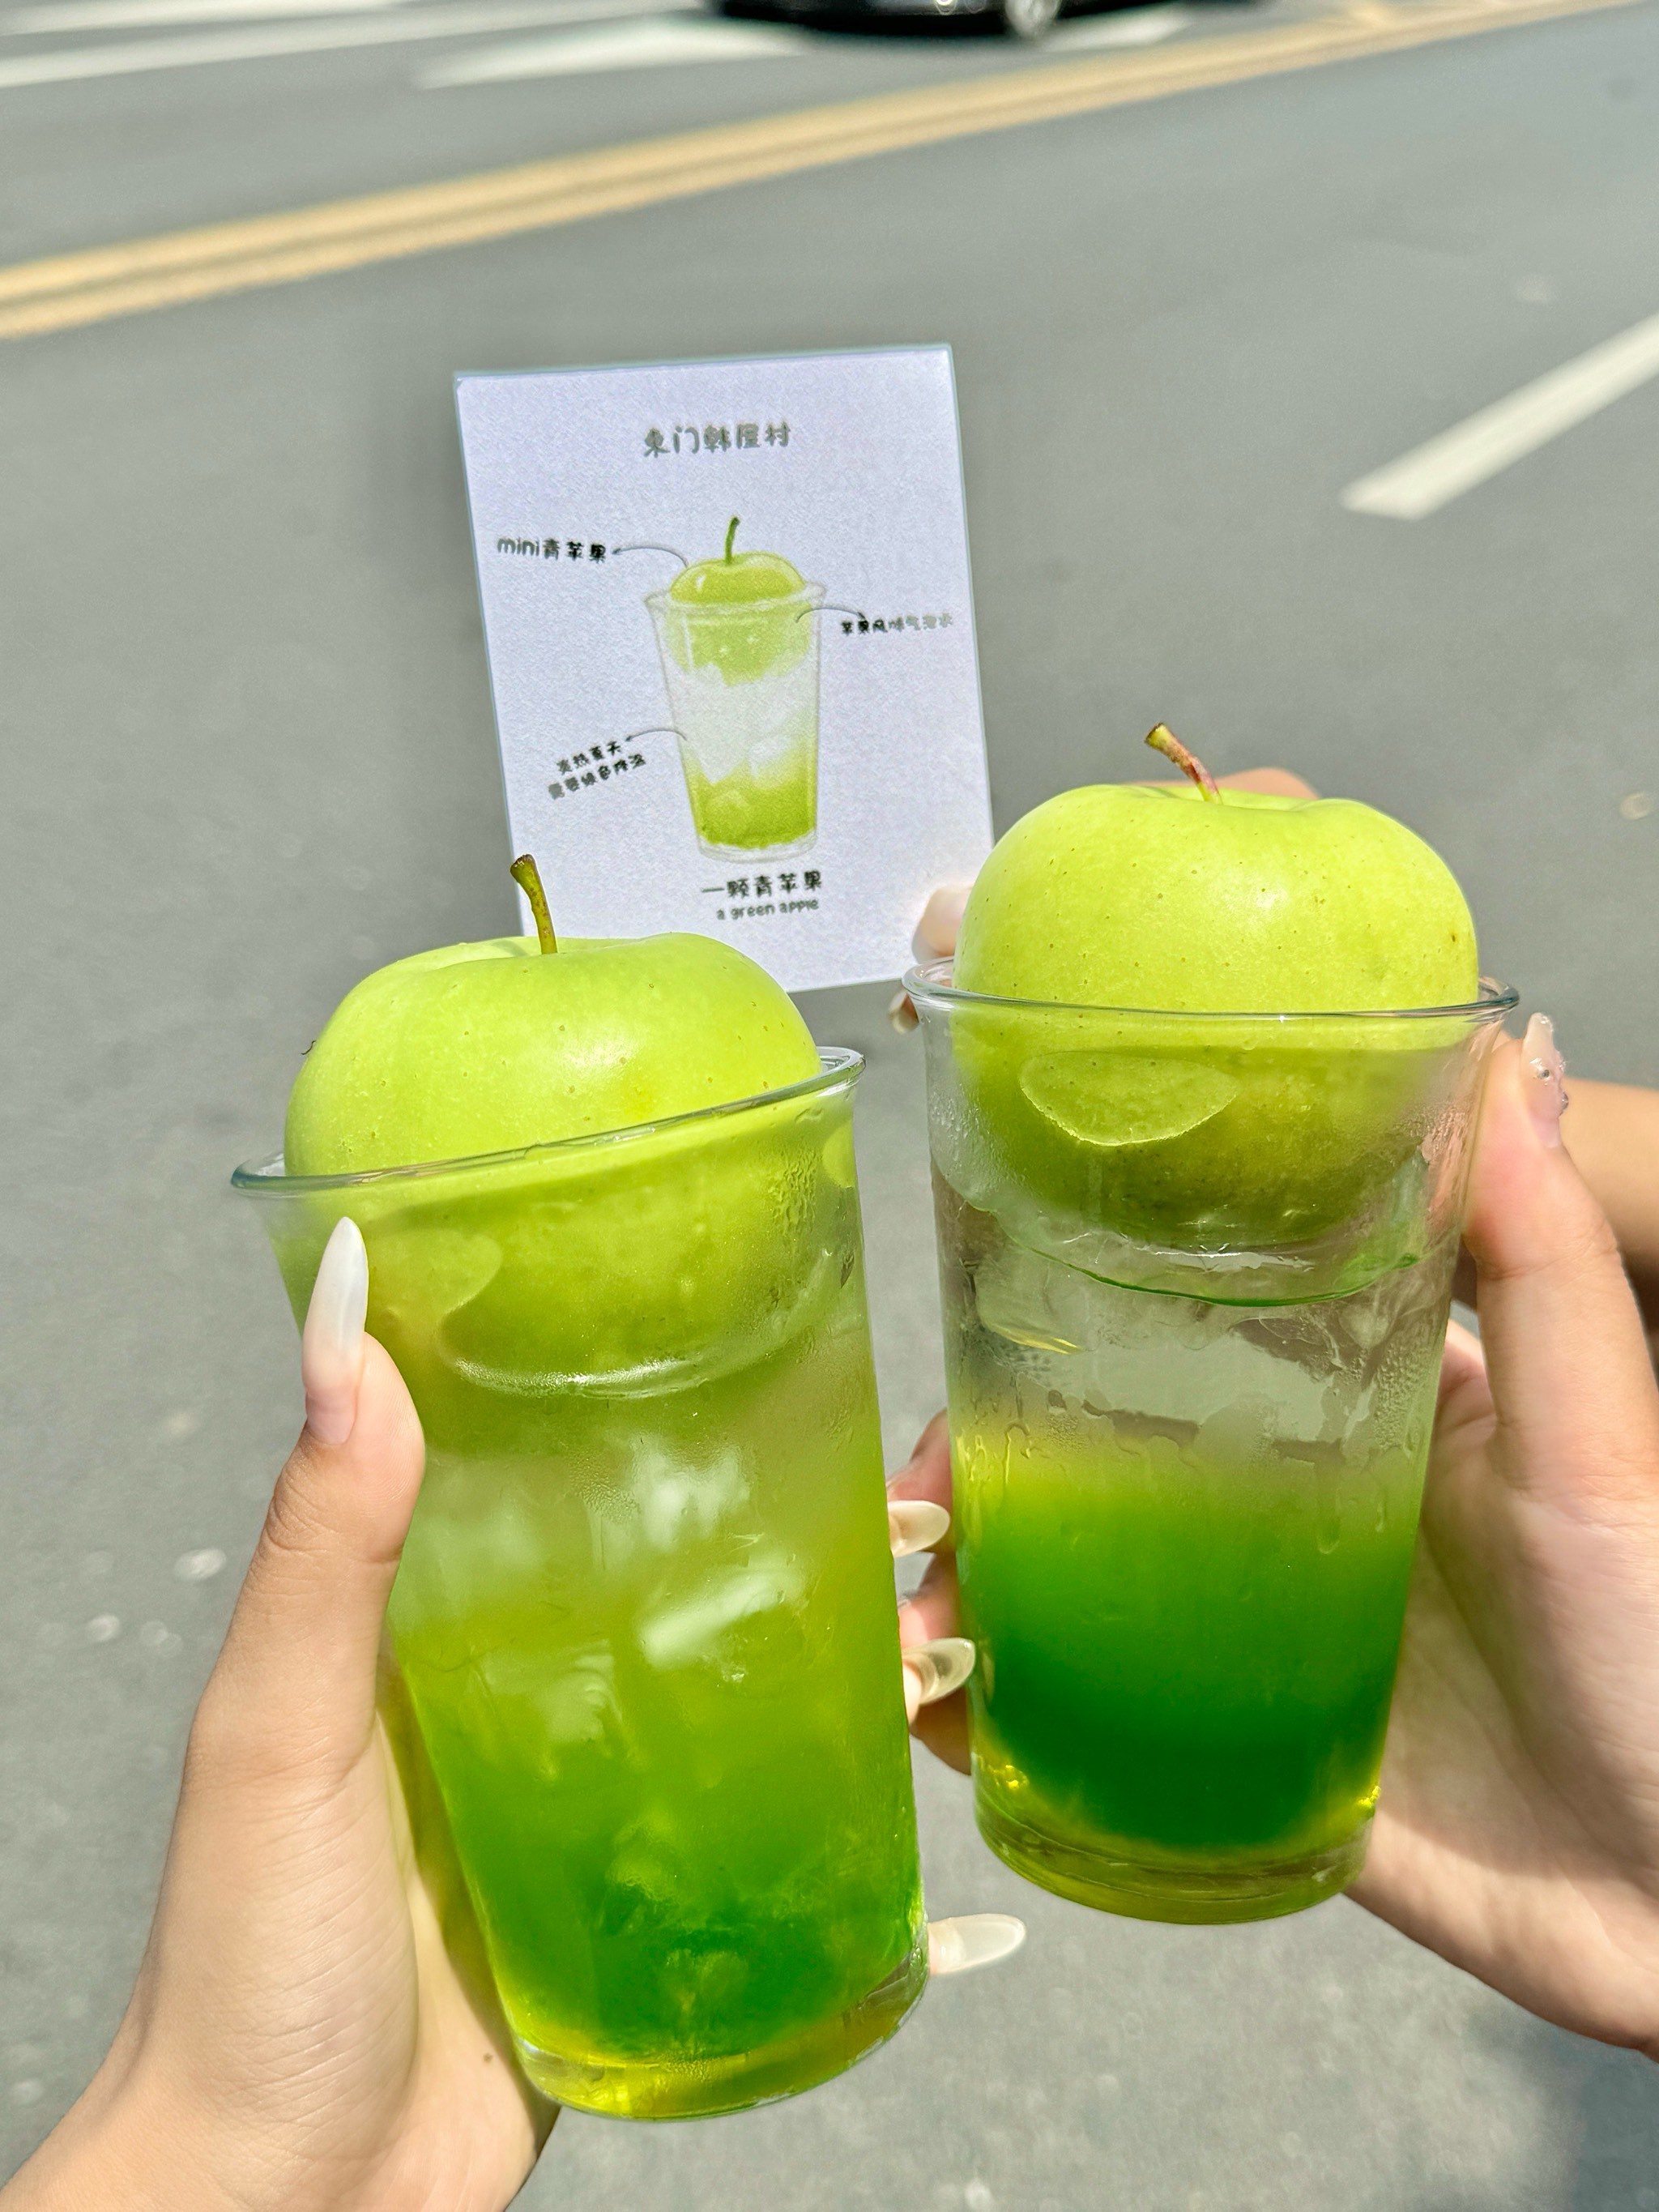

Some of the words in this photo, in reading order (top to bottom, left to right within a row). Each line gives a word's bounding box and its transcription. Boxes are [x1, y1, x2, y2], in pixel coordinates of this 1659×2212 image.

[497, 536, 607, 564] mini青苹果
[701, 869, 822, 898] 一颗青苹果
[716, 908, 726, 920] a
[730, 904, 775, 920] green
[779, 899, 820, 914] apple
